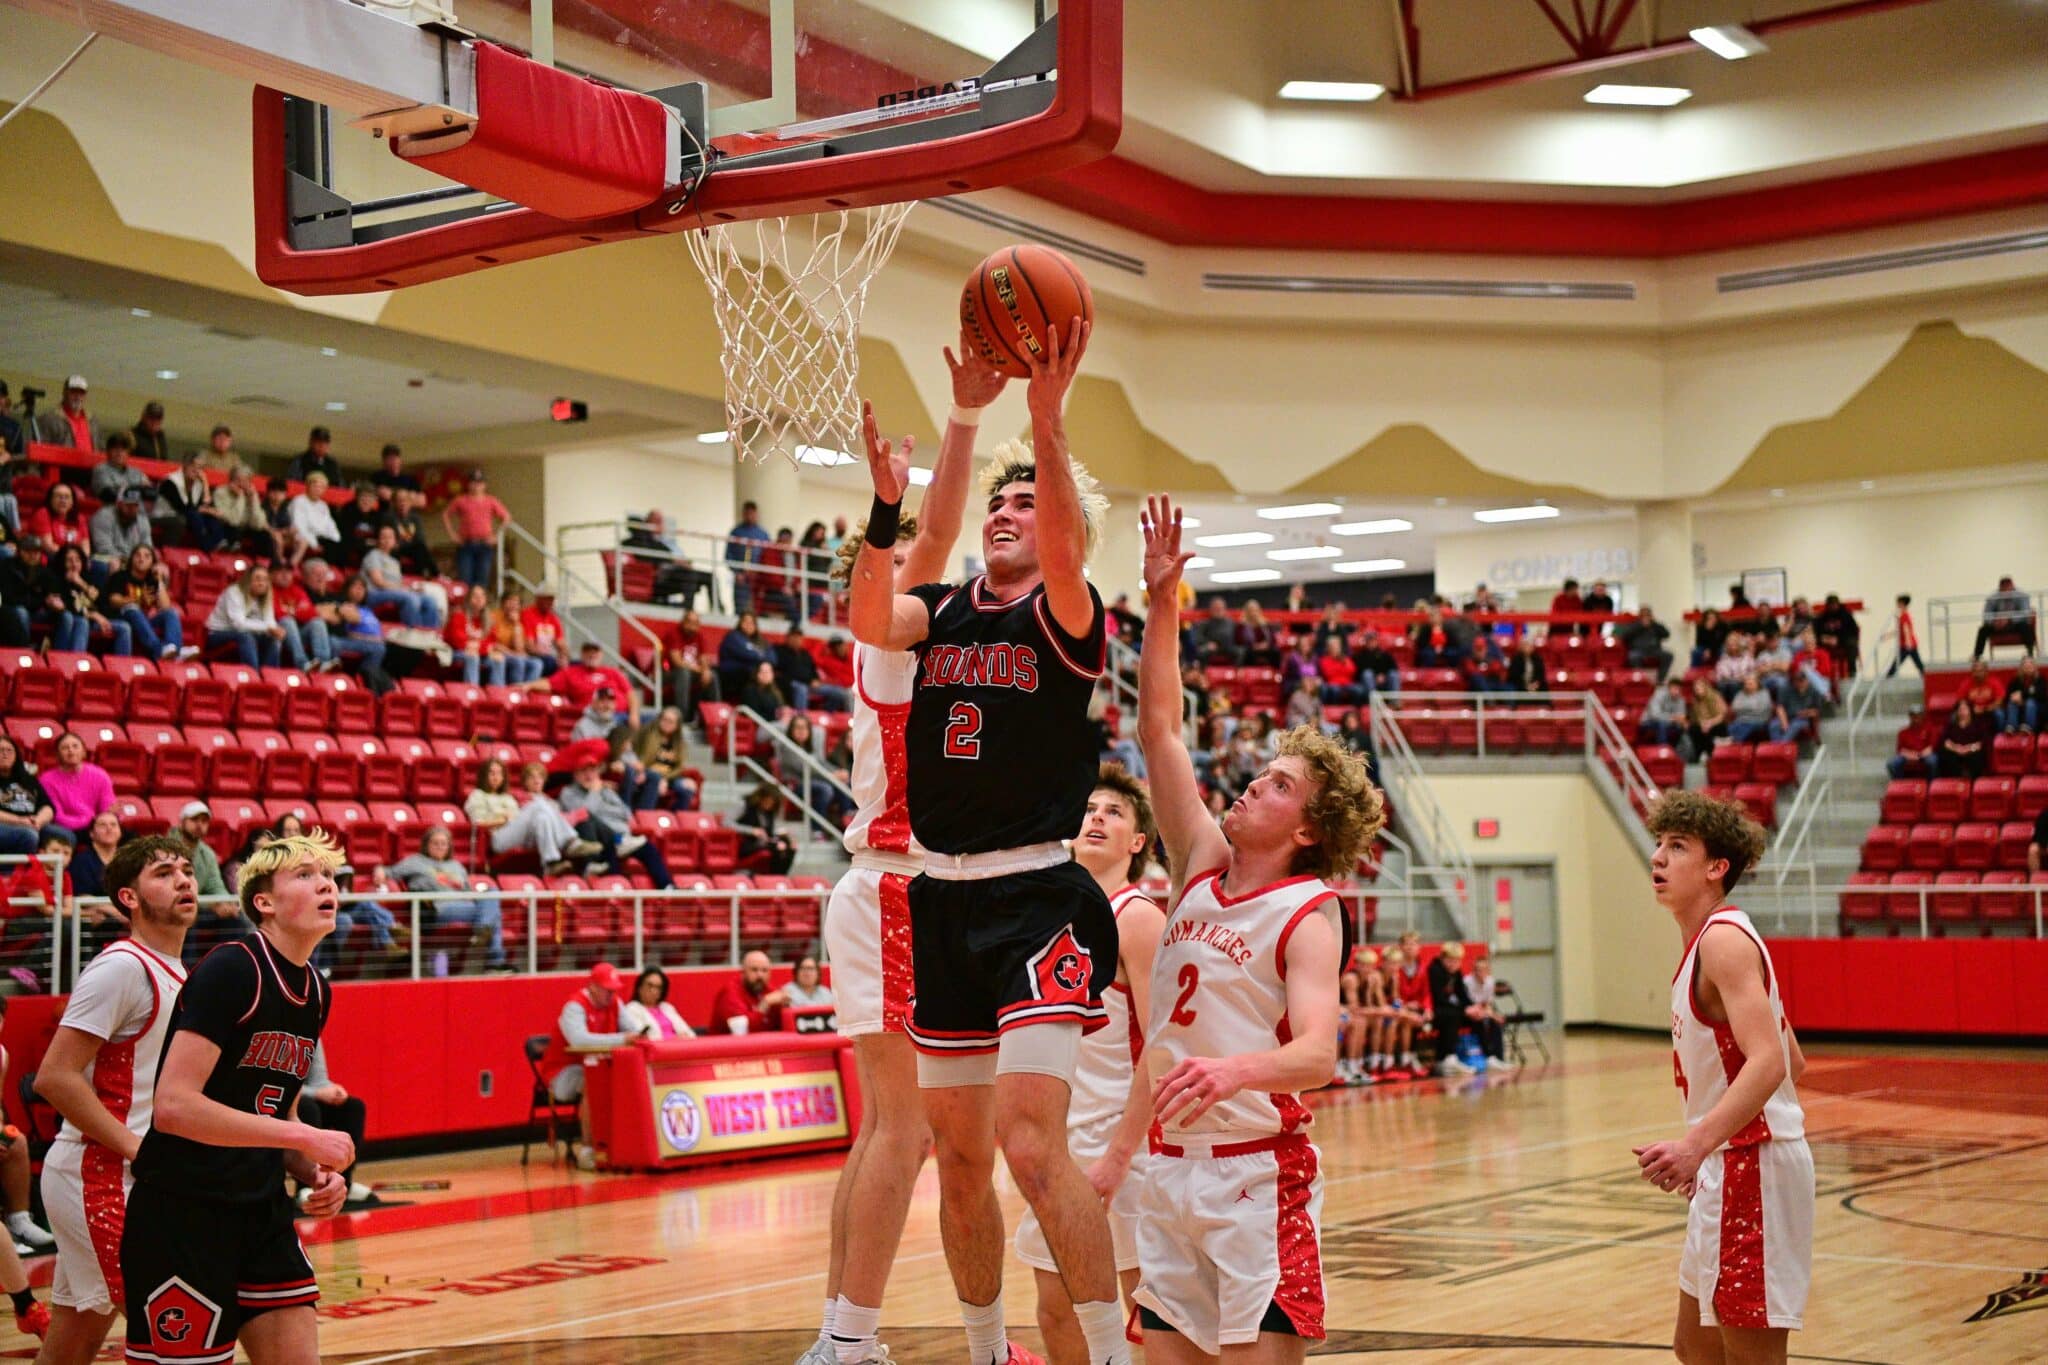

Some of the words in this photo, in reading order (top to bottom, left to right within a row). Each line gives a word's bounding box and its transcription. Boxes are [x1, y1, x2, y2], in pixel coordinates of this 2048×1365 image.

[944, 701, 982, 760] 2
[1163, 919, 1253, 967] OMANCHES
[1168, 963, 1199, 1027] 2
[703, 1091, 768, 1137] WEST
[771, 1084, 838, 1131] TEXAS
